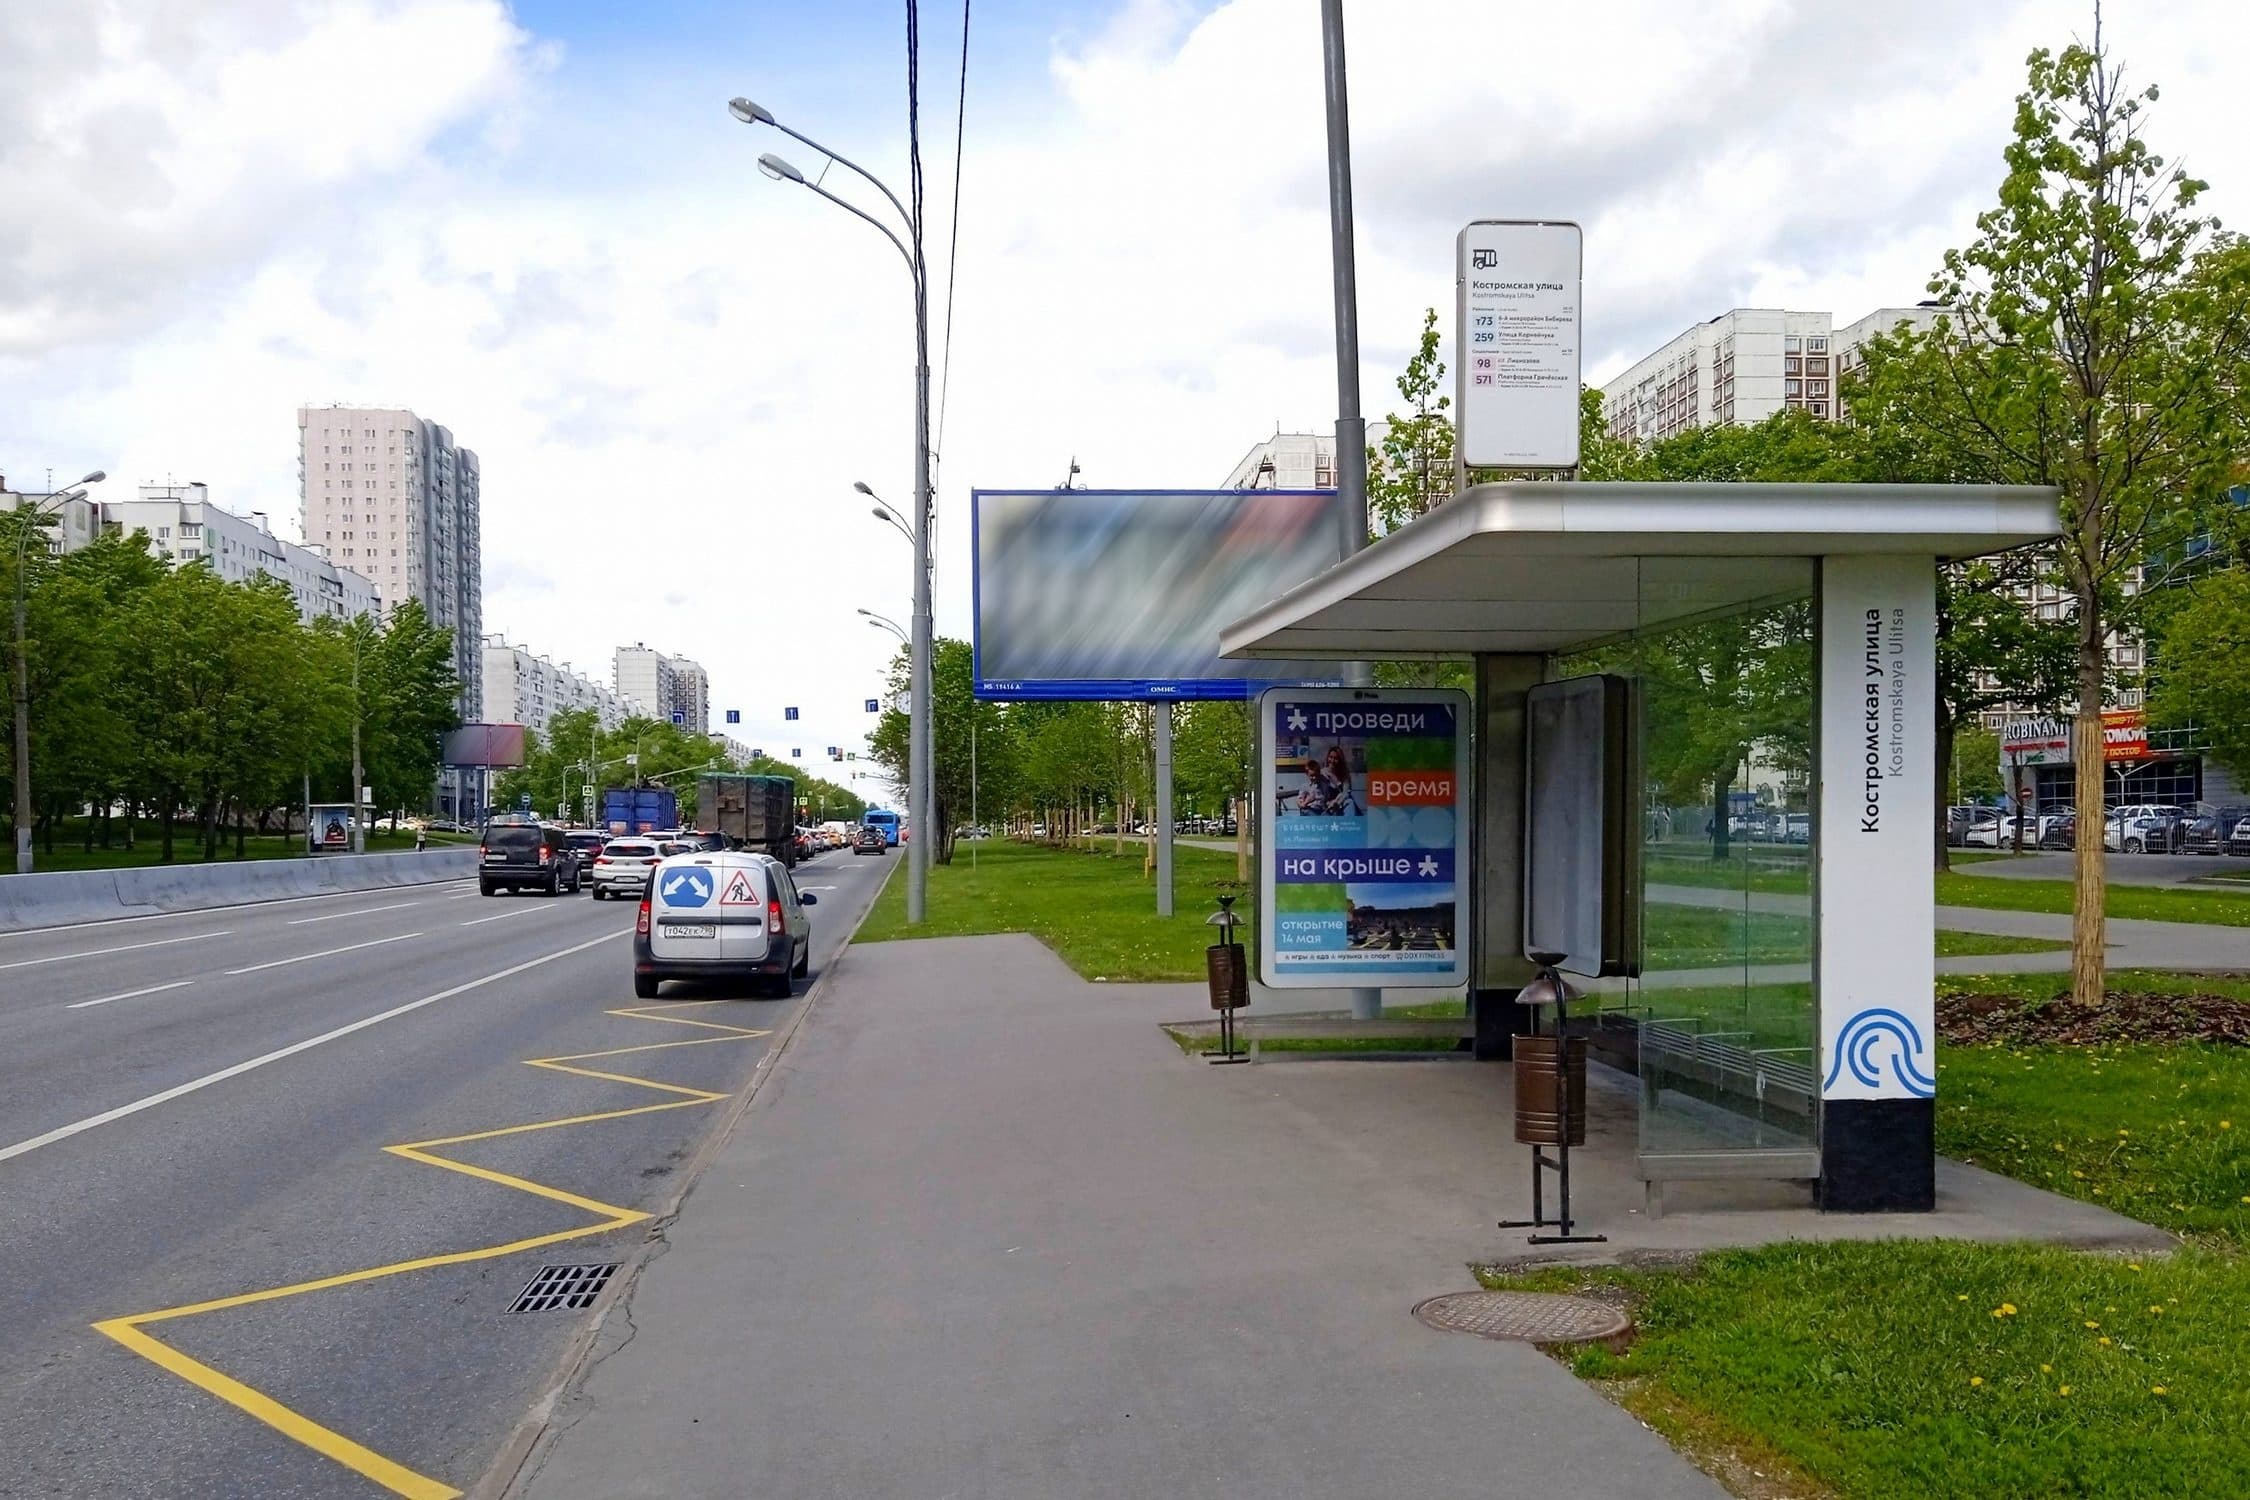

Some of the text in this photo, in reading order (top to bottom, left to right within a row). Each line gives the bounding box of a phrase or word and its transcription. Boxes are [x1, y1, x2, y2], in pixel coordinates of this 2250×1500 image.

[1472, 280, 1564, 291] Костромская улица
[1472, 292, 1516, 300] Kostromskaya
[1474, 332, 1494, 342] 259
[1477, 358, 1491, 368] 98
[1476, 375, 1492, 384] 571
[1888, 608, 1906, 777] Kostromskaya Ulitsa
[1316, 713, 1425, 733] проведи
[1861, 608, 1884, 833] Костромская улица
[1372, 780, 1450, 801] время
[1284, 858, 1411, 880] на крыше
[1281, 921, 1344, 932] открытие
[1281, 934, 1322, 944] 14 мая
[1370, 953, 1391, 961] спорт
